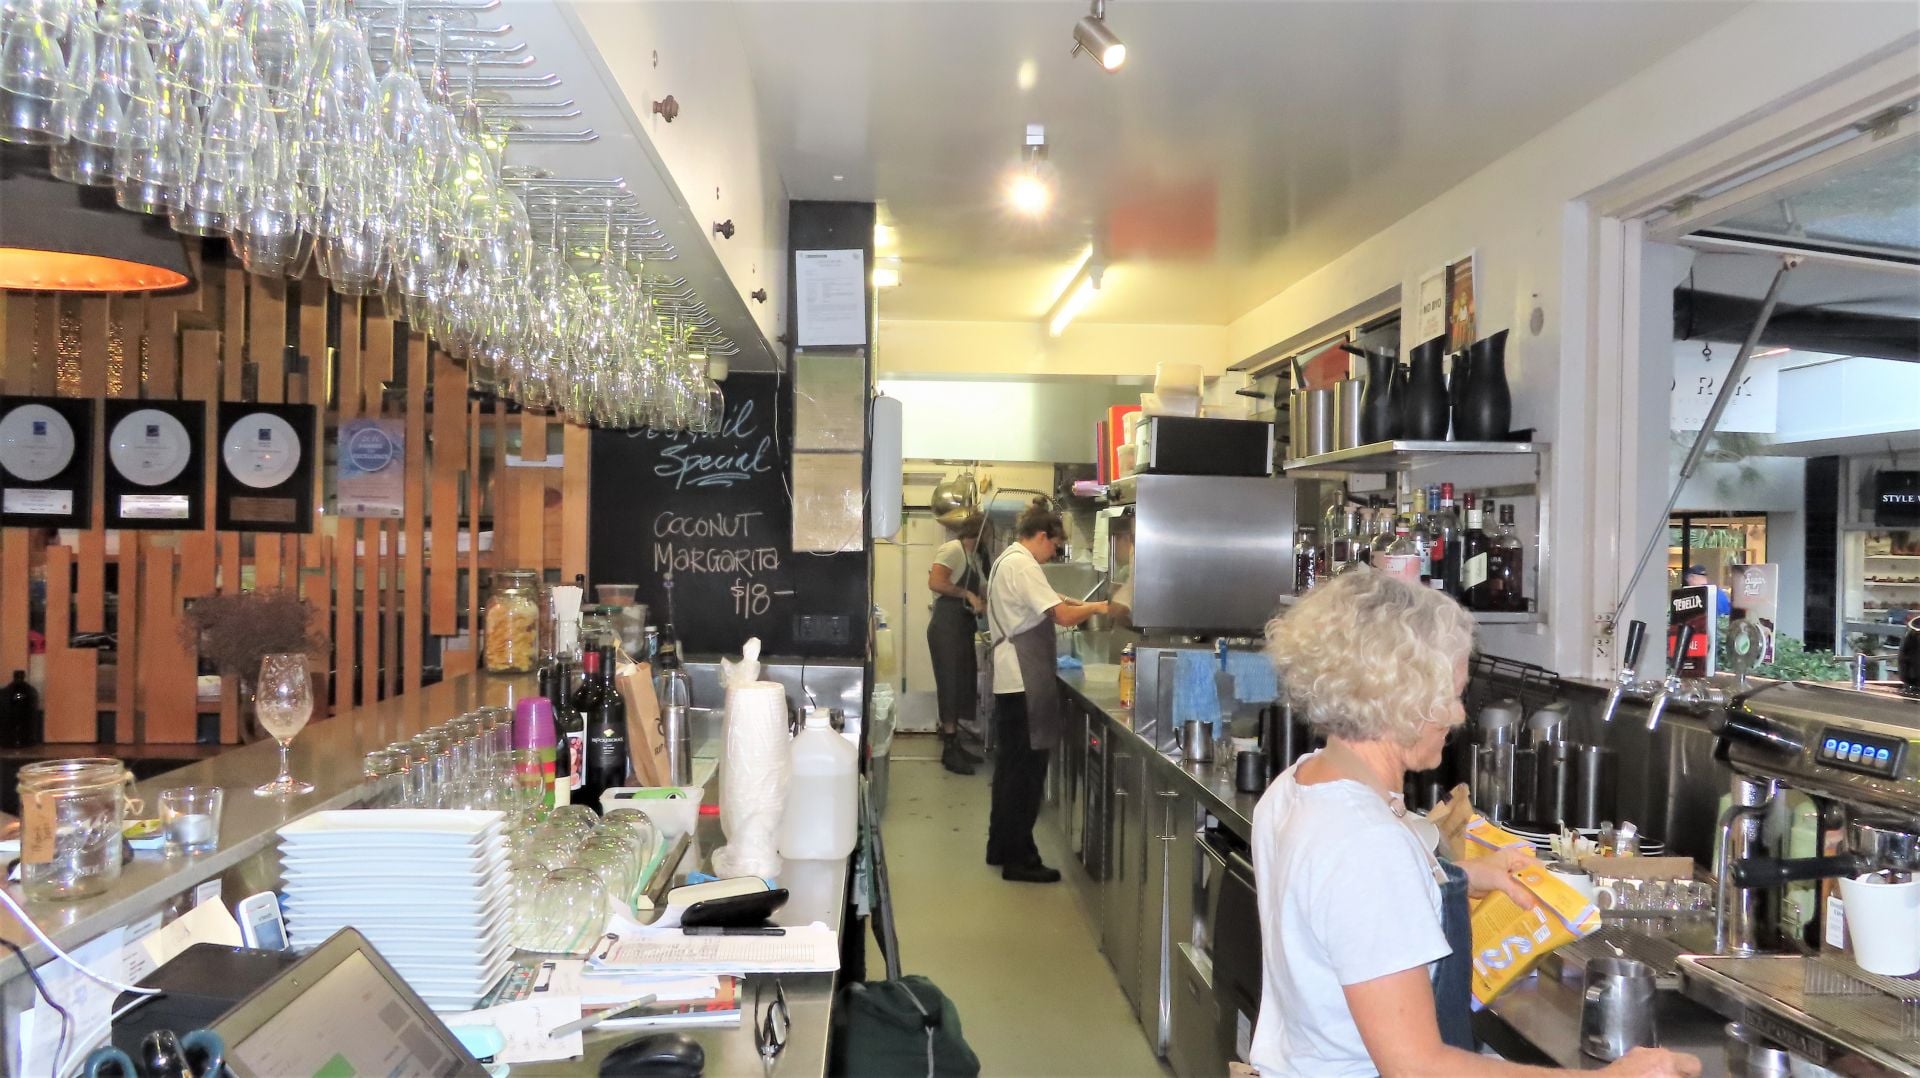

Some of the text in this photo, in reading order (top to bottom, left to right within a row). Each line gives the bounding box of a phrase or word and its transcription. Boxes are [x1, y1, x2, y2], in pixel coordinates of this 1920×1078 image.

[654, 436, 771, 490] Special
[1882, 494, 1915, 503] STYLE
[654, 511, 763, 537] COCONUT
[1673, 595, 1703, 612] TERELLA
